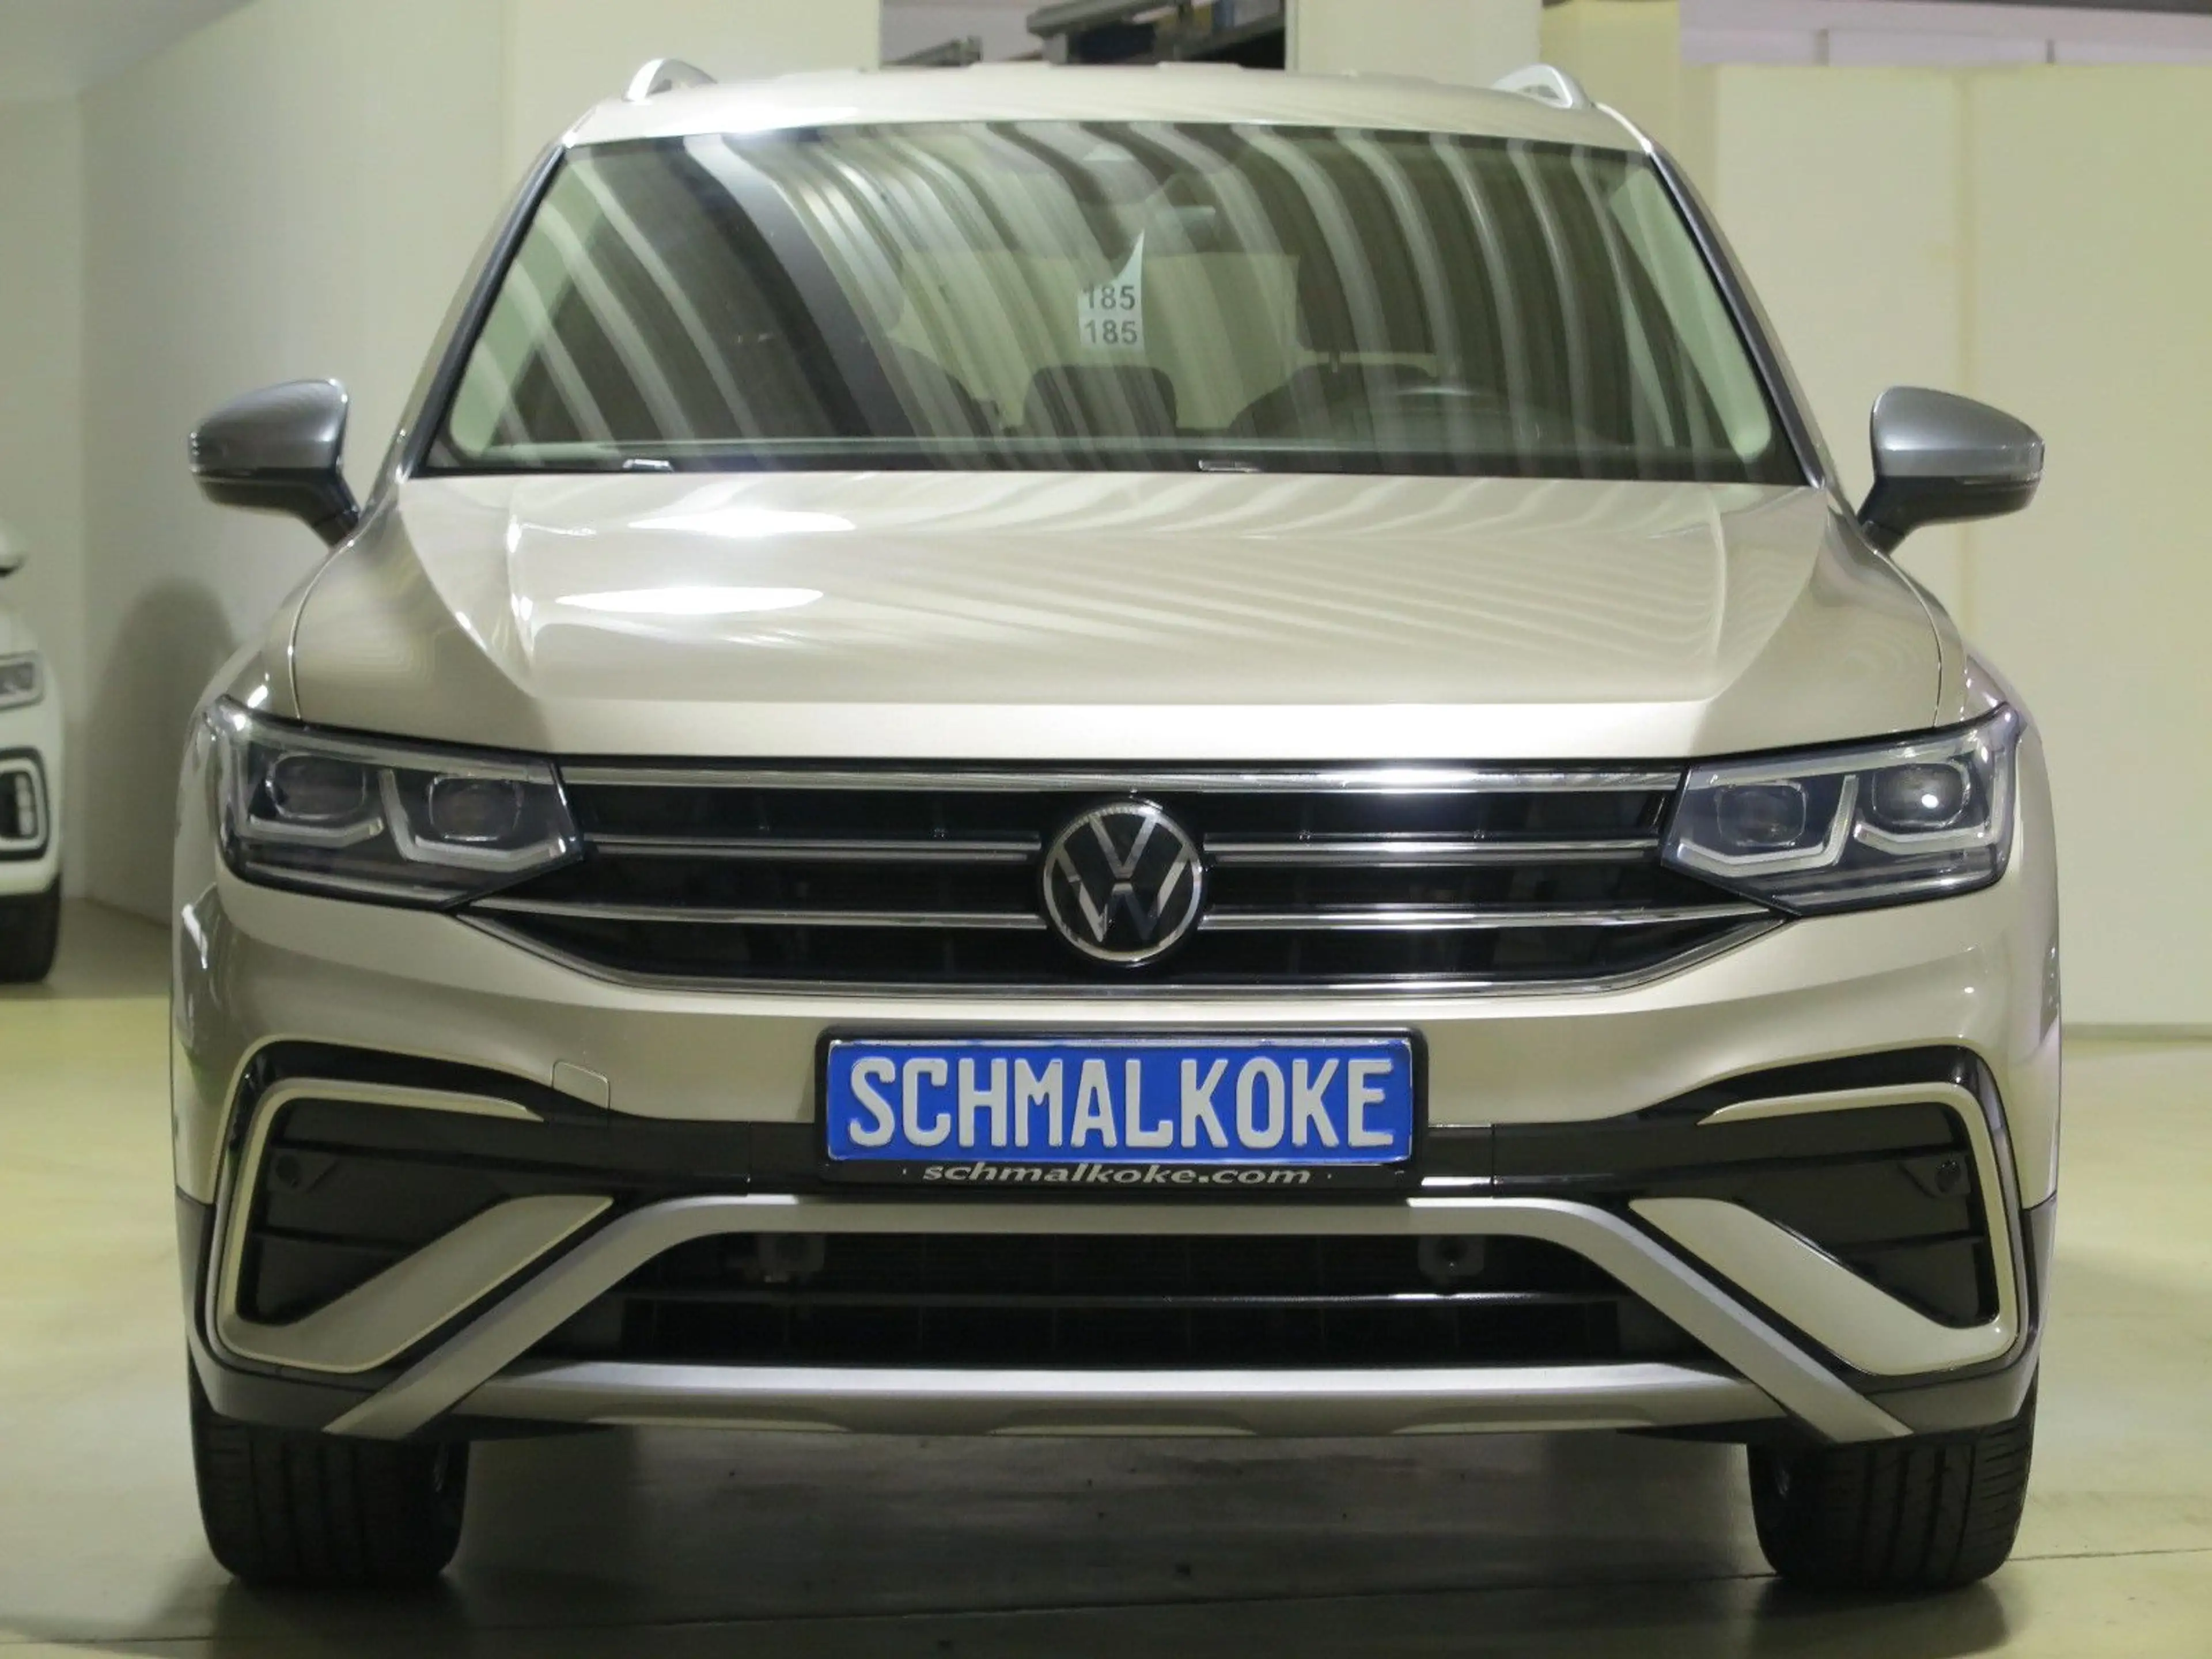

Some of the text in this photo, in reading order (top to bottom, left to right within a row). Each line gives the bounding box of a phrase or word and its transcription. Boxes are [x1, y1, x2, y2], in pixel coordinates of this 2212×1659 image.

[1085, 319, 1138, 344] 185
[847, 1058, 1395, 1149] SCHMALKOKE
[922, 1161, 1311, 1185] schmalkoke.com
